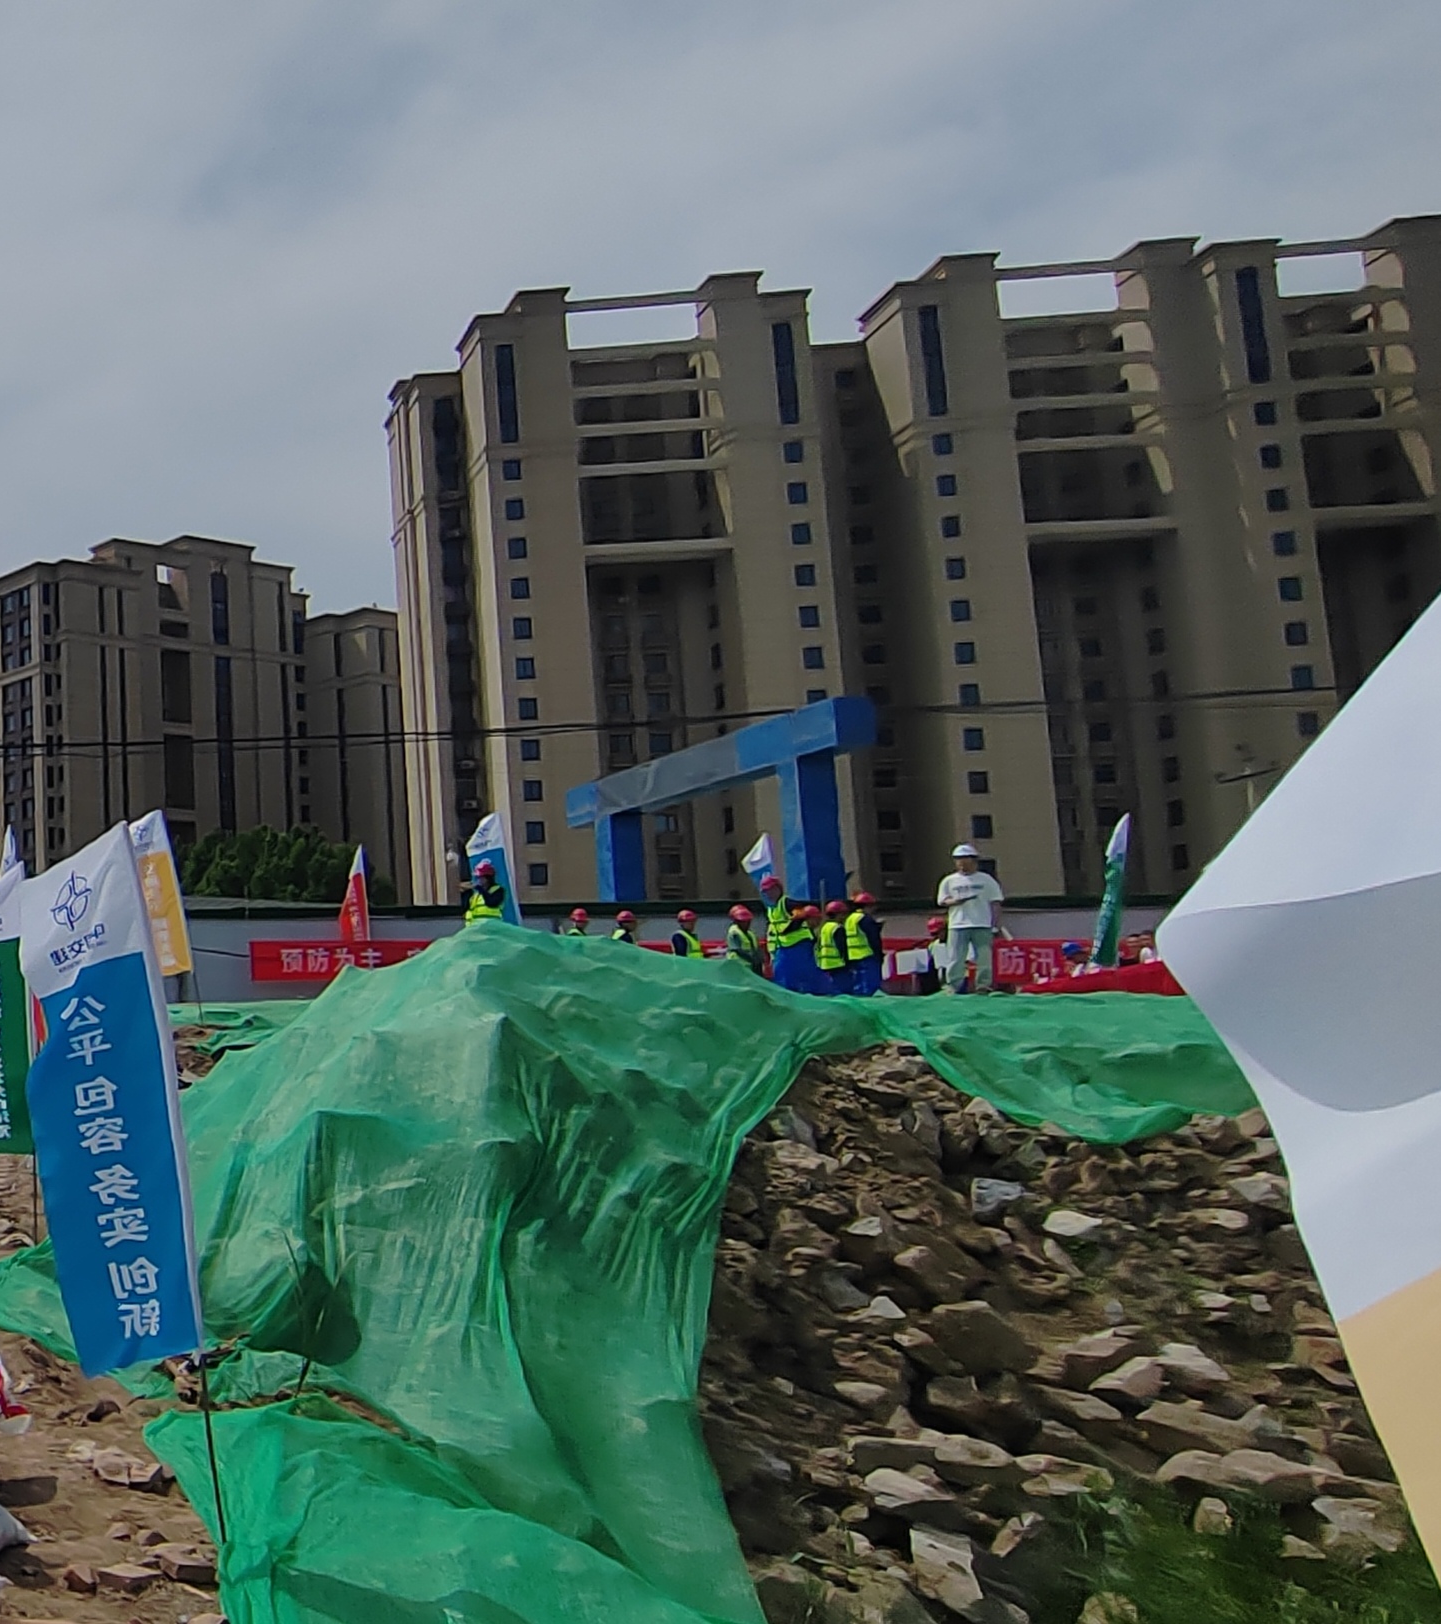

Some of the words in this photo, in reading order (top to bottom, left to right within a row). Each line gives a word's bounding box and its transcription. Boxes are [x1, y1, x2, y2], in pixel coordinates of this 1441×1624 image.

[281, 948, 383, 973] 预防为主
[998, 946, 1055, 975] 防汛
